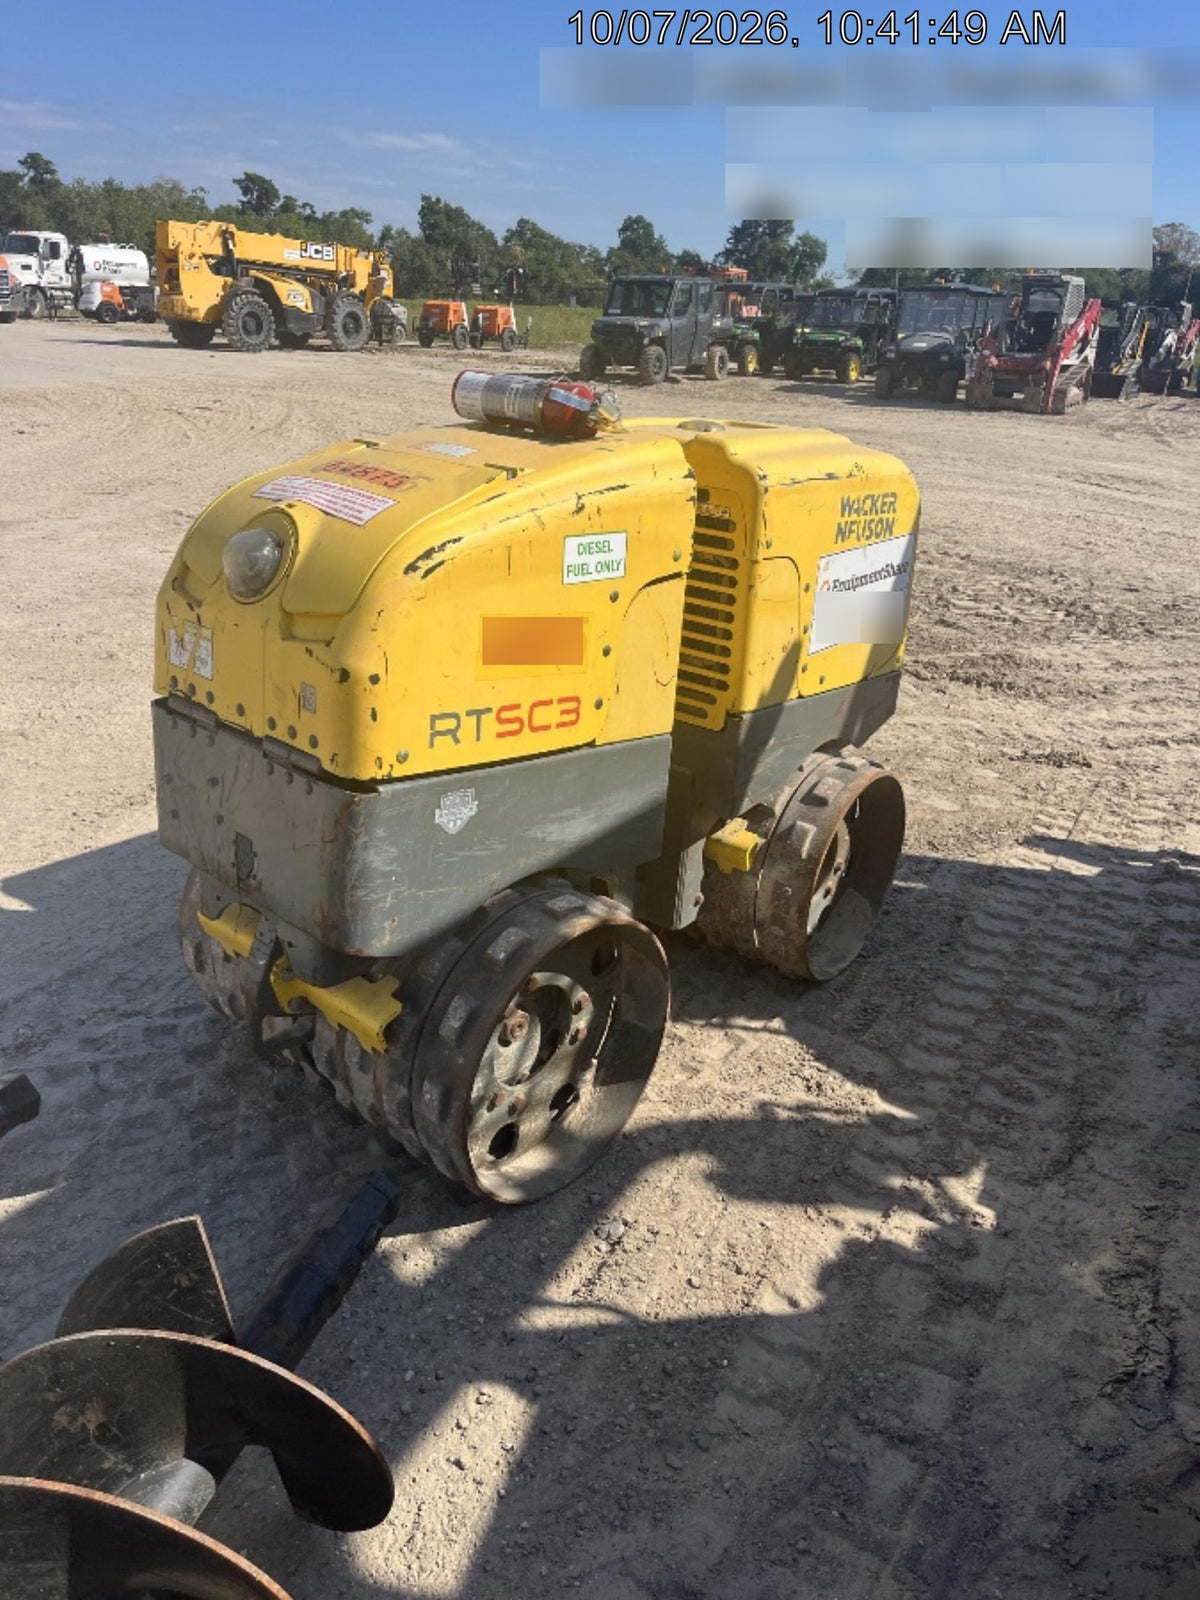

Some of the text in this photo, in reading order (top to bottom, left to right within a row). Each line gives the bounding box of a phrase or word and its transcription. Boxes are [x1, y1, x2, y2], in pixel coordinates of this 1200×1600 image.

[301, 242, 335, 261] JCB
[840, 492, 898, 517] WACKER
[577, 540, 614, 556] DIESEL
[566, 558, 623, 578] FUEL ONLY
[428, 695, 582, 749] RTSC3
